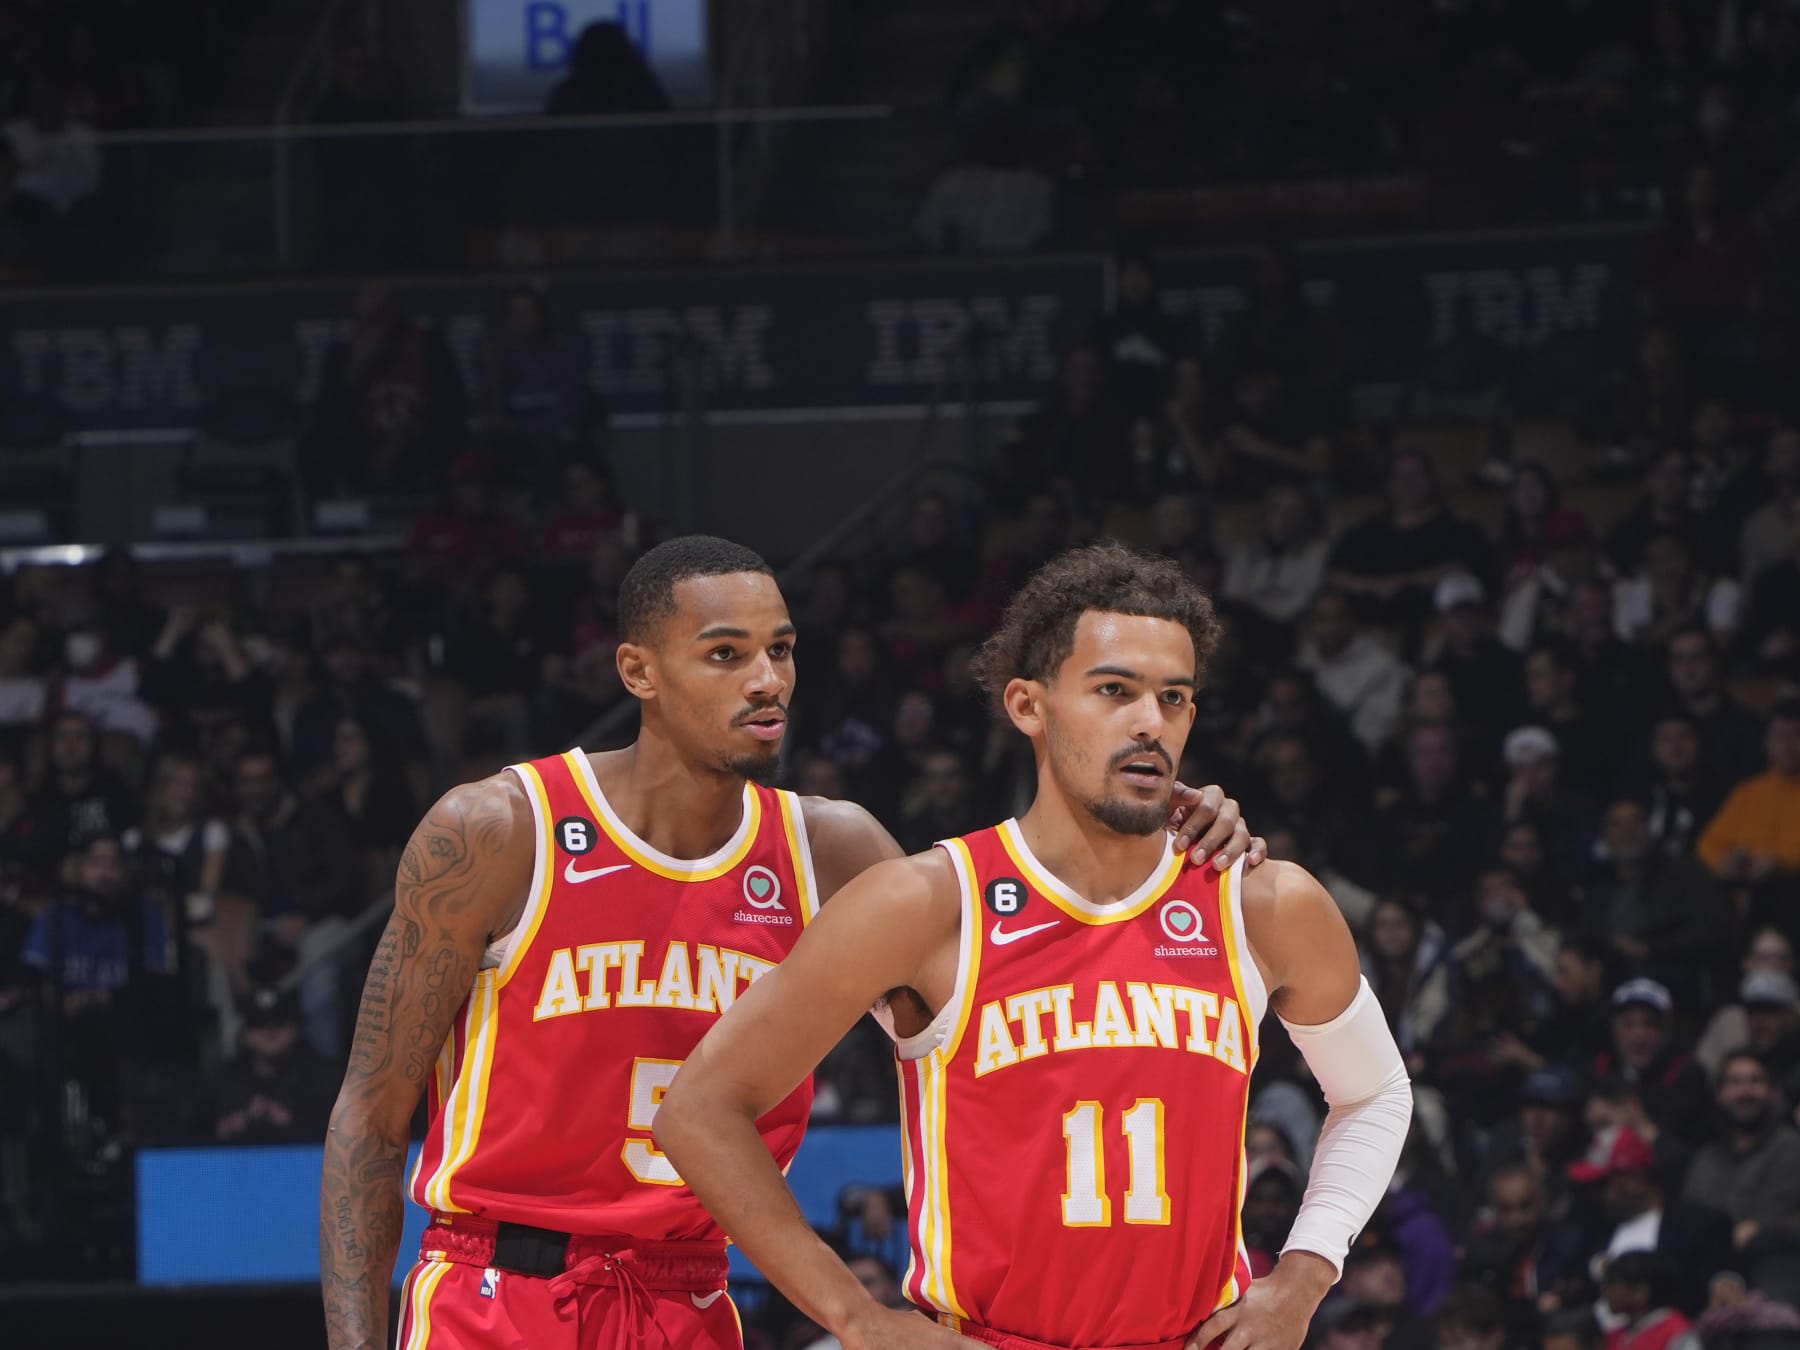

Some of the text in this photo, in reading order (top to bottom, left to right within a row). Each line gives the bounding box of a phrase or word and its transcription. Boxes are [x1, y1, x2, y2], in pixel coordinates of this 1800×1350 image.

[12, 323, 203, 411] IBM
[563, 821, 588, 852] 6
[734, 909, 793, 925] sharecare
[994, 883, 1017, 912] 6
[1154, 944, 1218, 957] sharecare
[974, 980, 1248, 1079] ATLANTA
[621, 1056, 686, 1186] 5
[1060, 1097, 1171, 1228] 11
